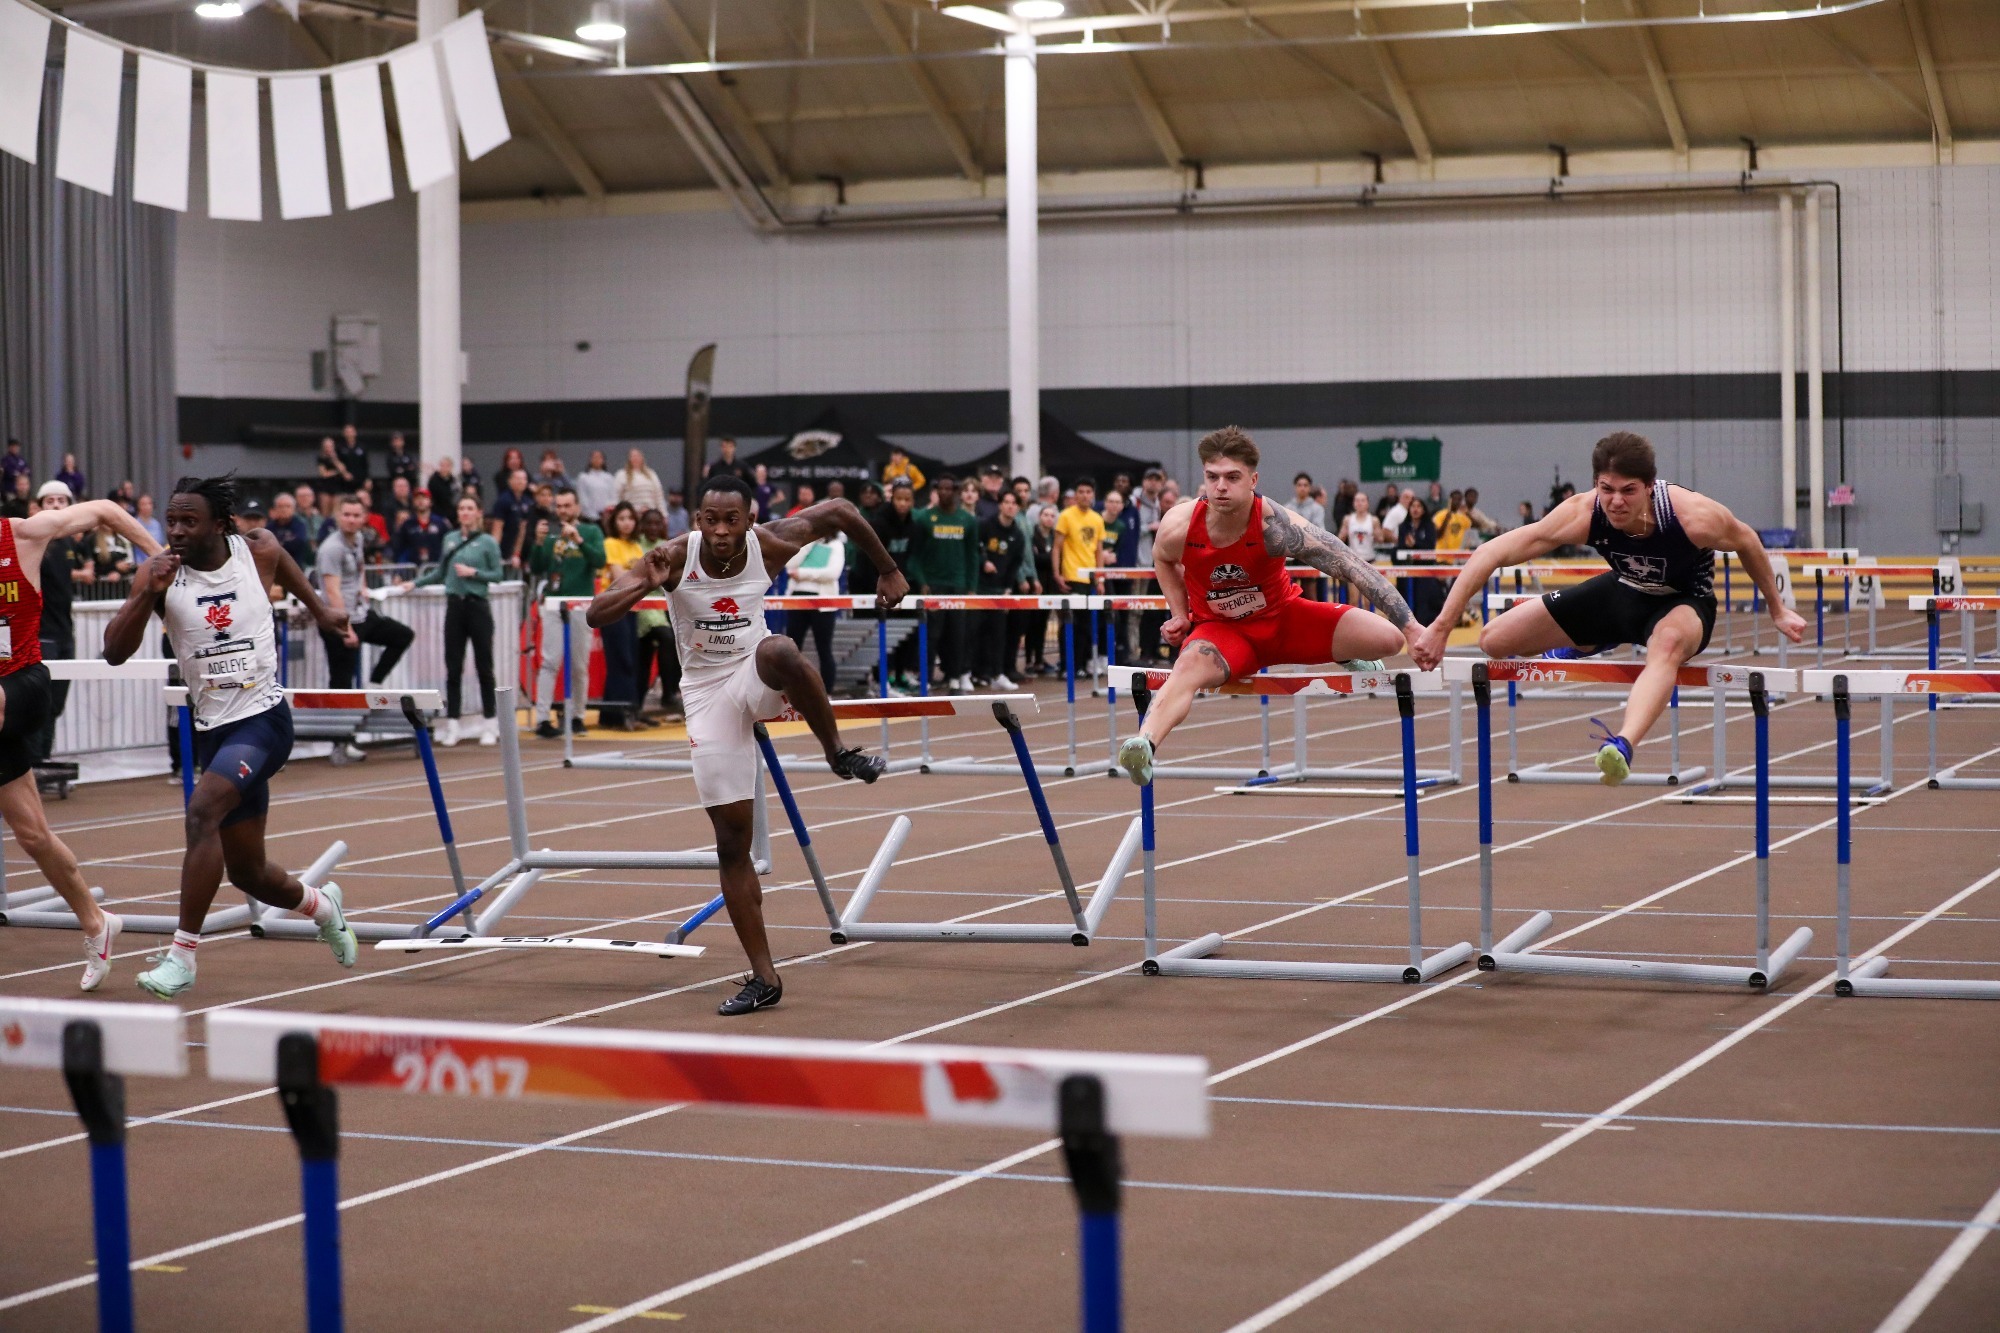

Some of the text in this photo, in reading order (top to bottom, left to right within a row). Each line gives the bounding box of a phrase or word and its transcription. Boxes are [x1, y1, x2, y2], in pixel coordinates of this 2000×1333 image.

[1859, 574, 1872, 593] 9
[1941, 575, 1955, 593] 8
[1217, 593, 1257, 611] SPENCER
[1953, 602, 1985, 611] 2017
[708, 634, 736, 645] LINDO
[208, 658, 249, 675] ADELEYE
[1488, 661, 1538, 671] WINNIPEG
[1516, 670, 1567, 682] 2017
[393, 1052, 530, 1099] 2017
